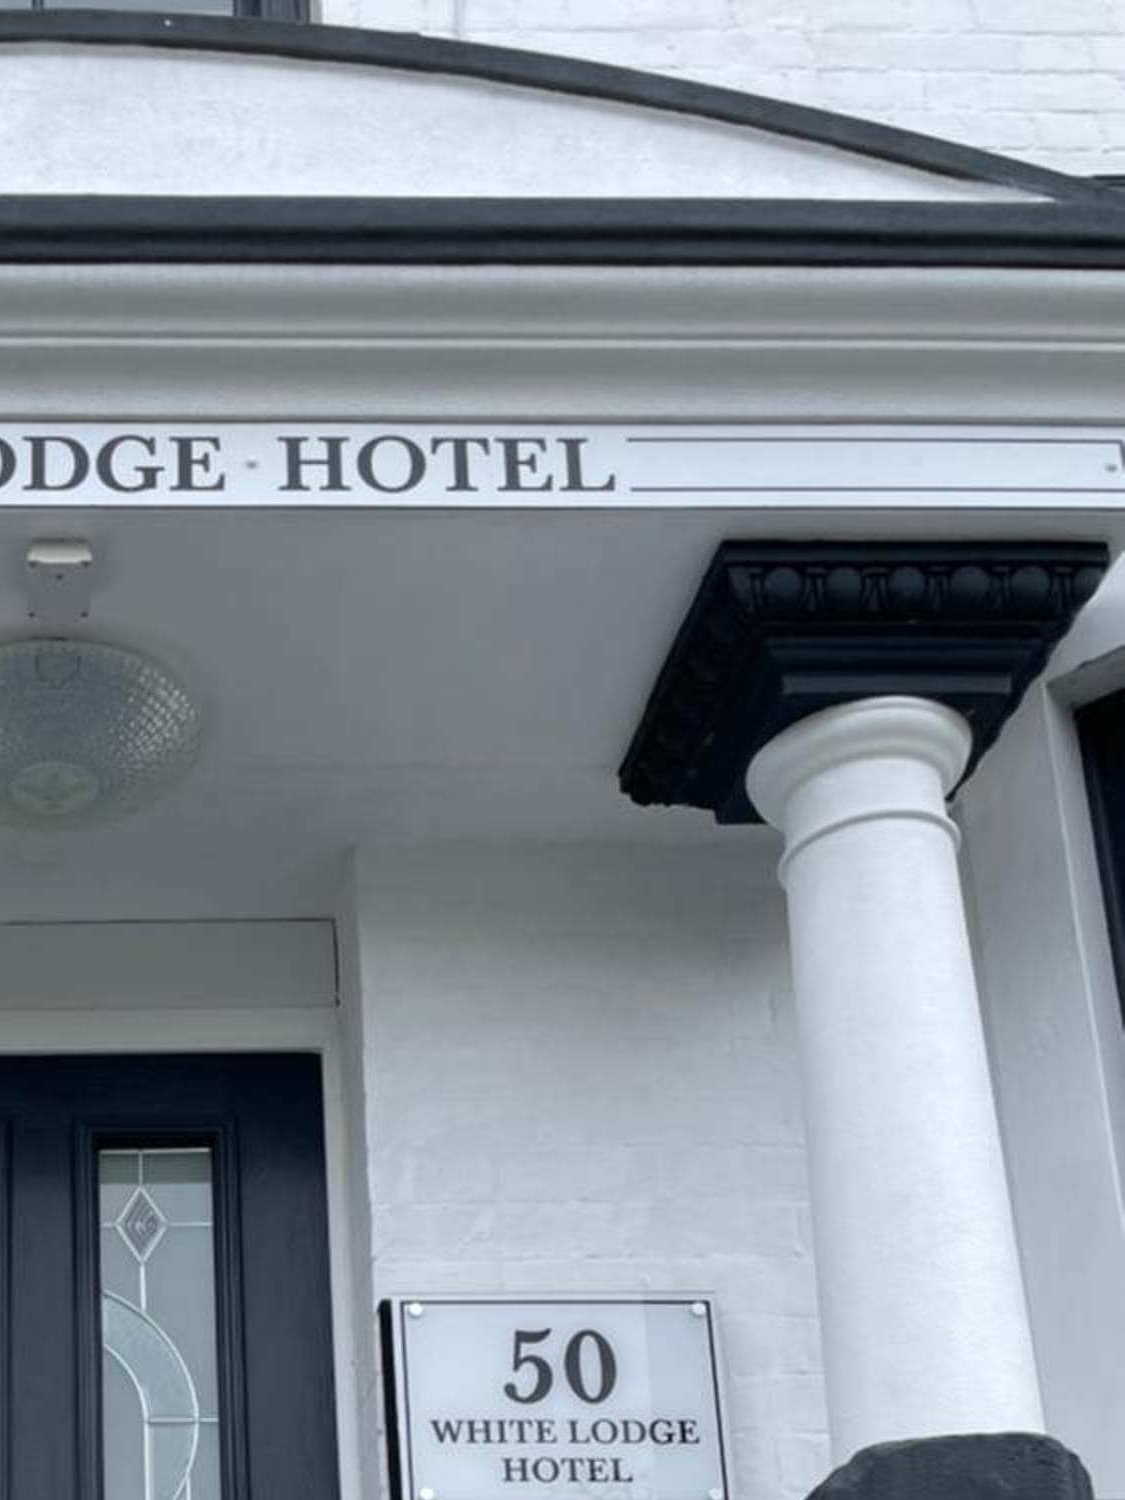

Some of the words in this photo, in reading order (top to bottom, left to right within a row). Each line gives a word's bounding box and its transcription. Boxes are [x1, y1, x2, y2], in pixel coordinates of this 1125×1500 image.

[277, 434, 617, 493] HOTEL
[503, 1327, 617, 1404] 50
[430, 1419, 557, 1444] WHITE
[568, 1419, 701, 1445] LODGE
[502, 1456, 634, 1483] HOTEL
